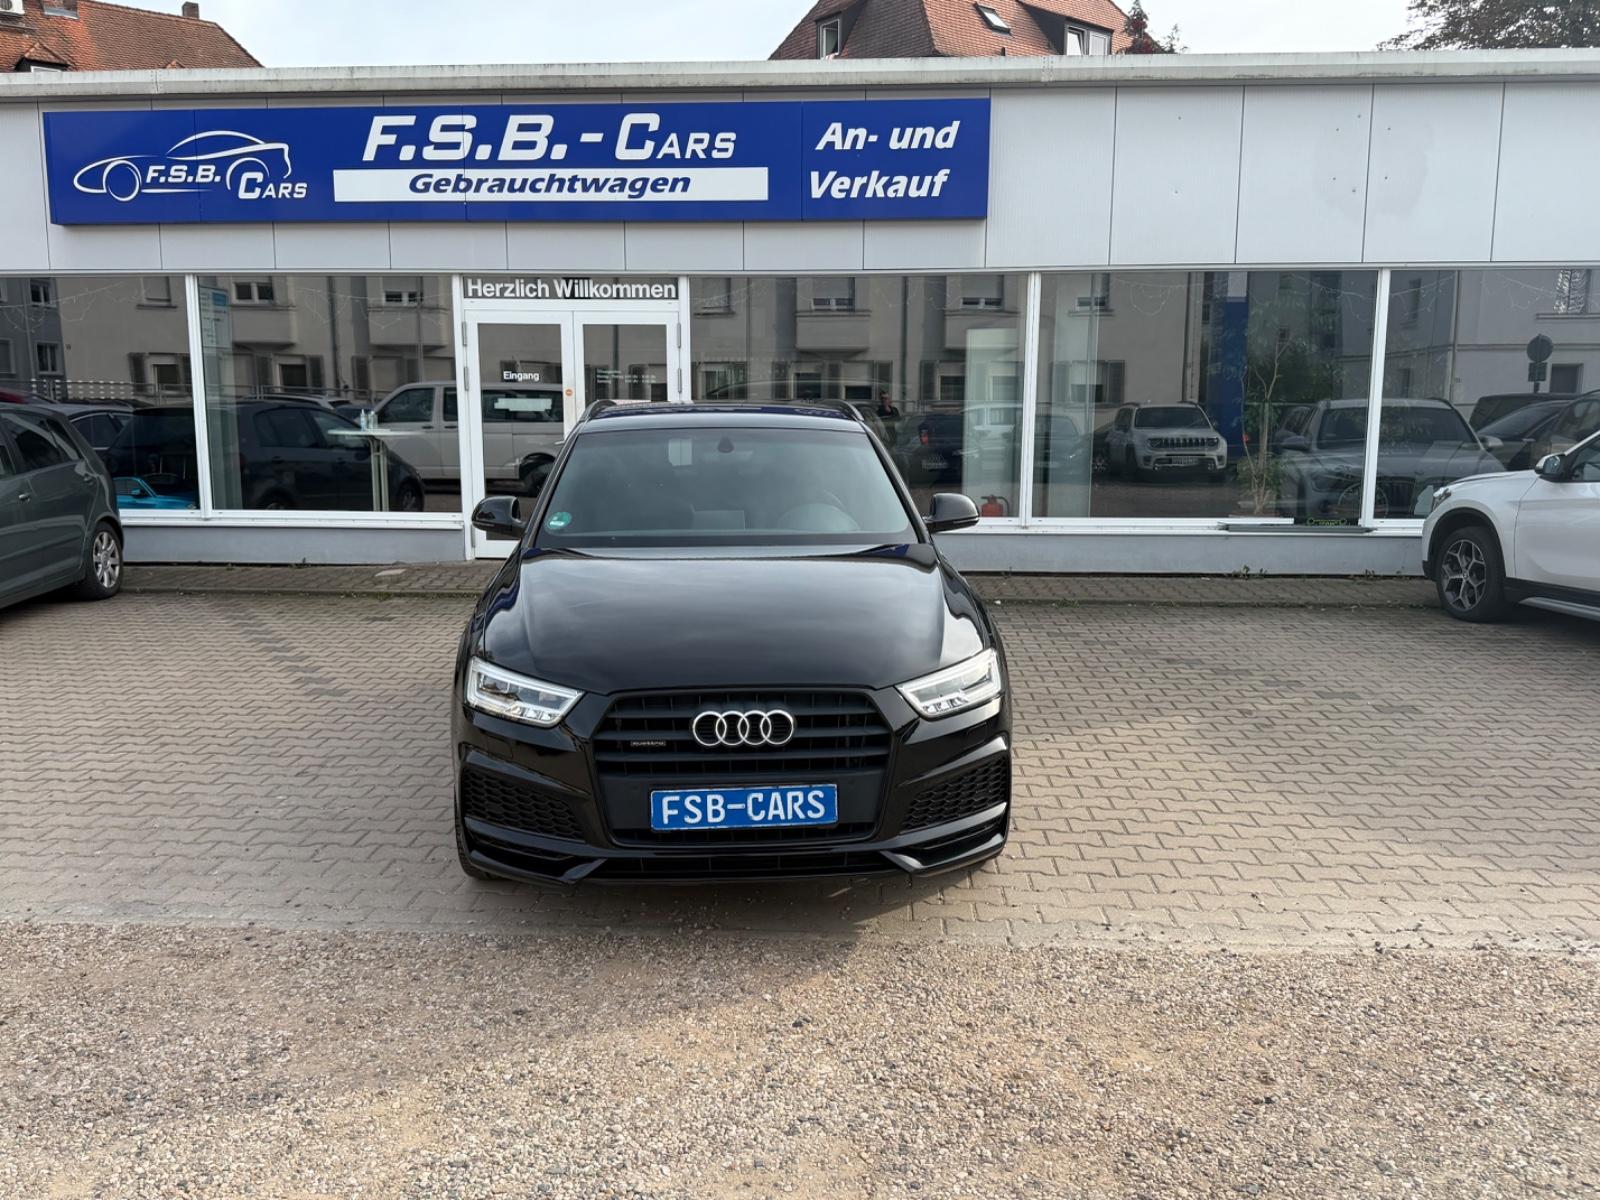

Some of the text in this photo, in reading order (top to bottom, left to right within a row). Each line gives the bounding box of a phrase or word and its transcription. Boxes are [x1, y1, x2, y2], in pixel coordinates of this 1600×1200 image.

[362, 114, 568, 161] F.S.B.
[814, 121, 961, 150] An- und
[145, 164, 222, 184] F.S.B.
[408, 173, 691, 200] Gebrauchtwagen
[809, 168, 950, 200] Verkauf
[467, 278, 677, 299] Herzlich Willkommen
[503, 370, 540, 382] Eingang
[661, 790, 826, 825] FSB-CARS
